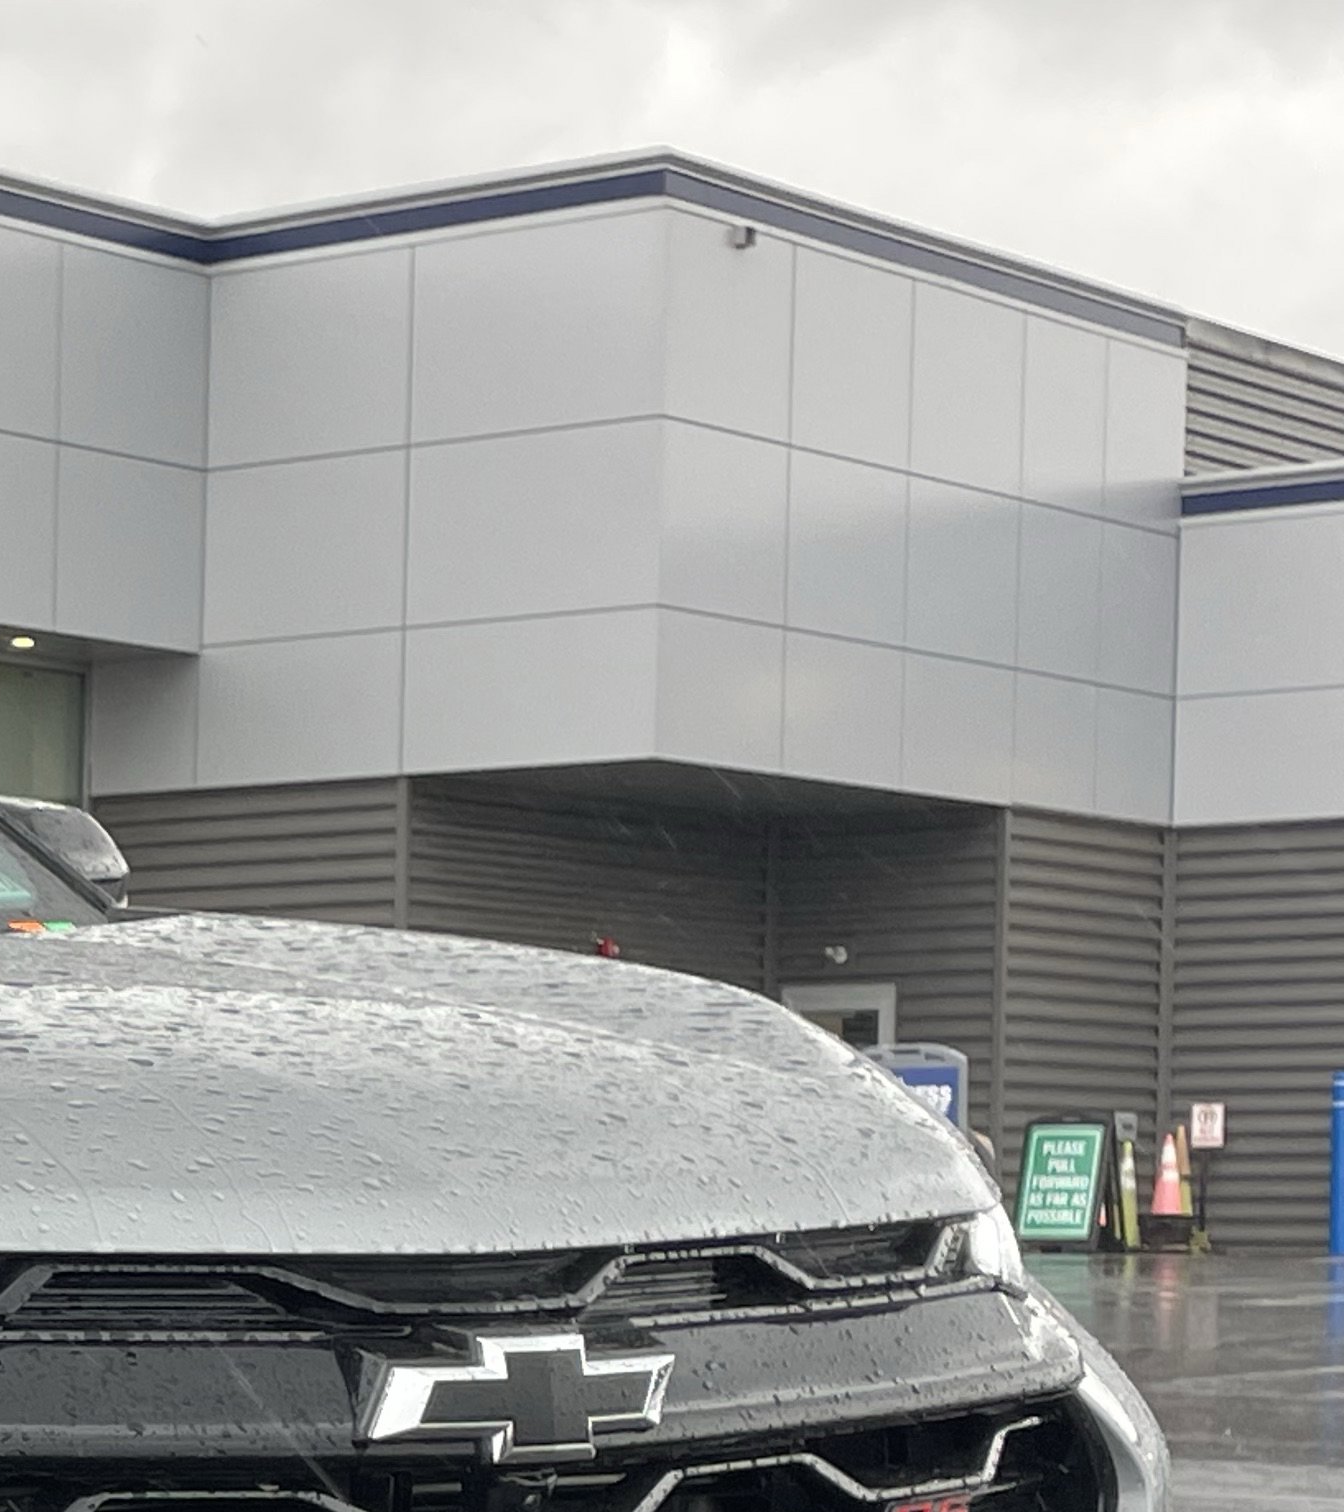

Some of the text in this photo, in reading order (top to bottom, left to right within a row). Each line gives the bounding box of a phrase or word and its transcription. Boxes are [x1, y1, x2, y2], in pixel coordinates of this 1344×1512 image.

[1042, 1140, 1087, 1157] PLEASE
[1047, 1157, 1076, 1174] PULL
[1031, 1174, 1089, 1191] FORWARD
[1029, 1191, 1087, 1207] AS FAR AS
[1026, 1208, 1084, 1225] POSSIBLE
